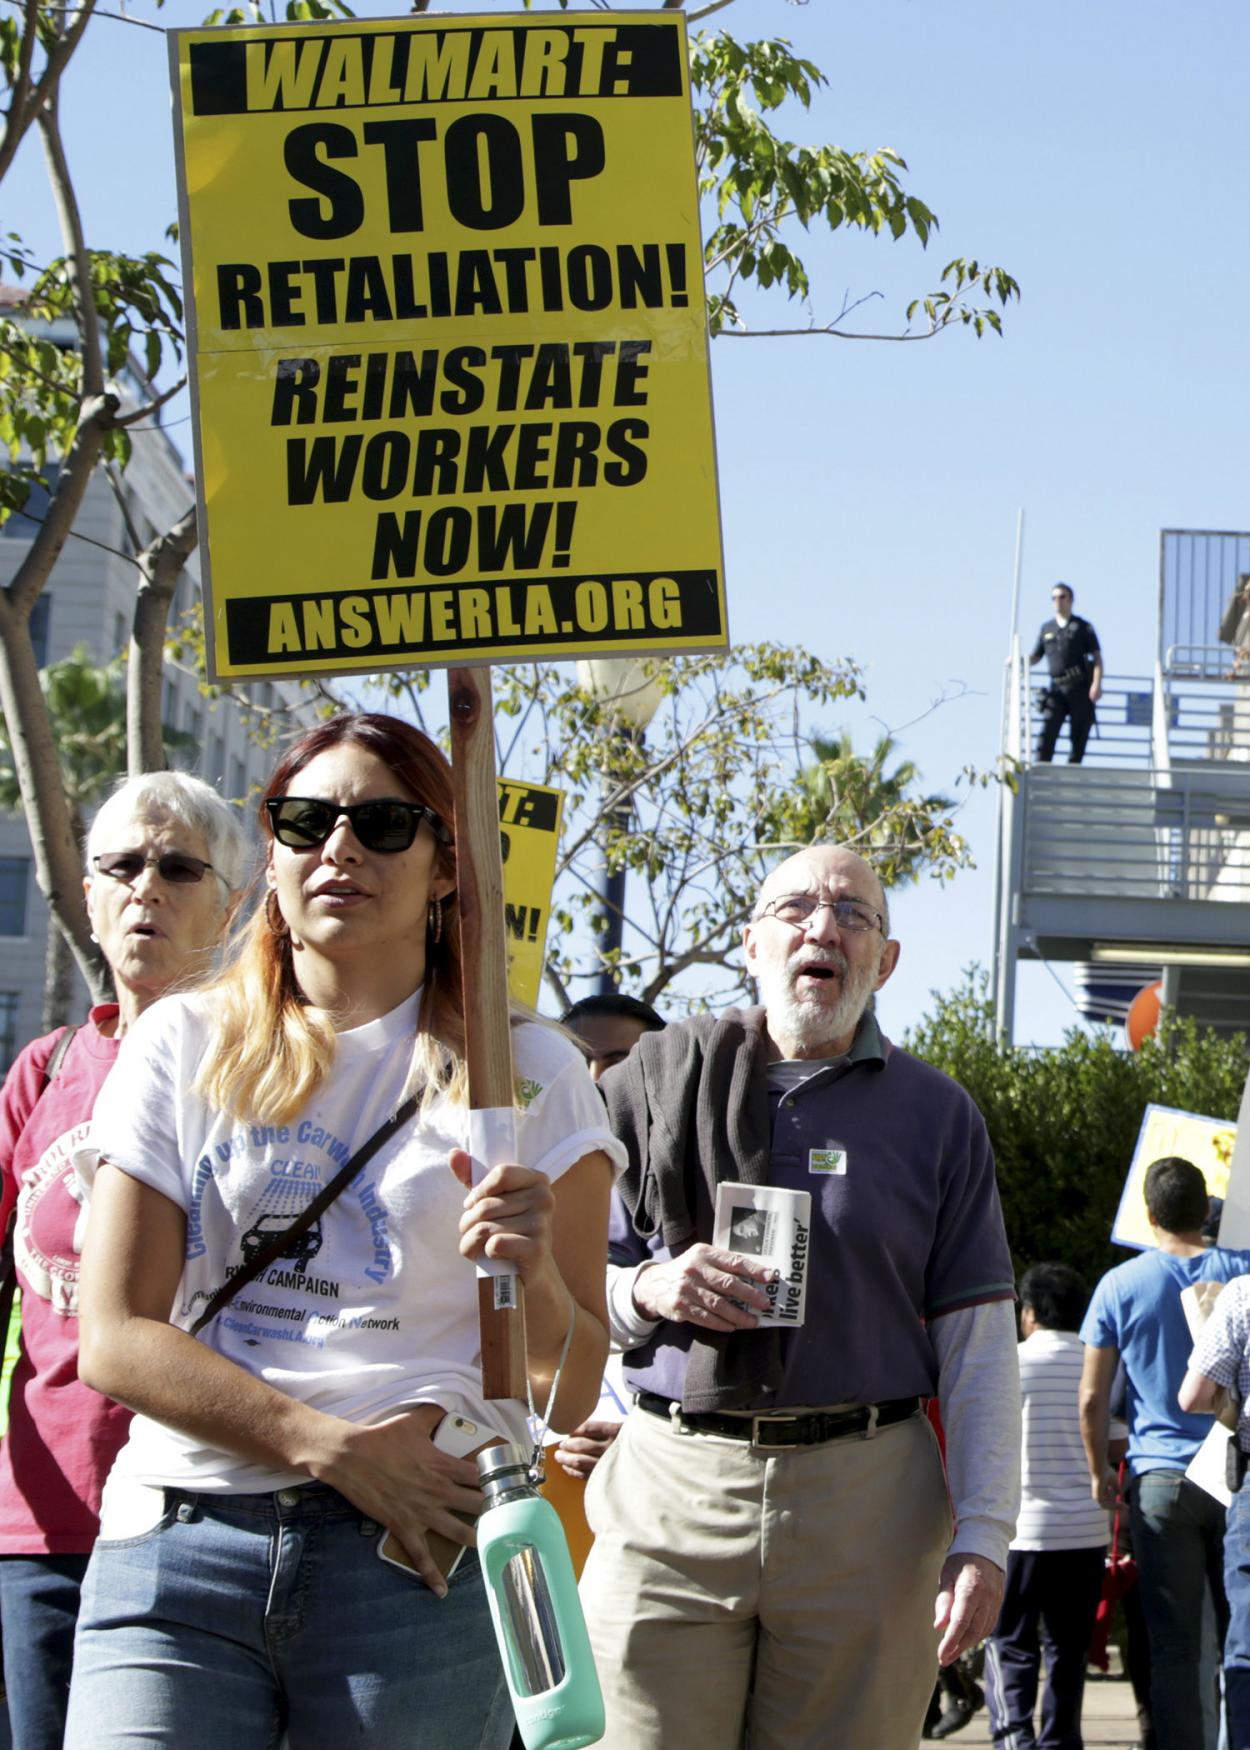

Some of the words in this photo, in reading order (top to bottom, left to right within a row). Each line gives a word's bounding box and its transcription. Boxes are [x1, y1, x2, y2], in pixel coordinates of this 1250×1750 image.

[245, 28, 632, 111] WALMART:
[283, 112, 606, 240] STOP
[216, 243, 689, 330] RETALIATION!
[270, 340, 652, 426] REINSTATE
[286, 418, 650, 506] WORKERS
[371, 501, 578, 580] NOW!
[266, 578, 683, 654] ANSWERLA.ORG
[250, 1124, 290, 1148] the
[358, 1182, 391, 1285] Industry
[267, 1268, 340, 1299] CAMPAIGN
[350, 1315, 400, 1332] Network
[779, 1287, 802, 1320] live
